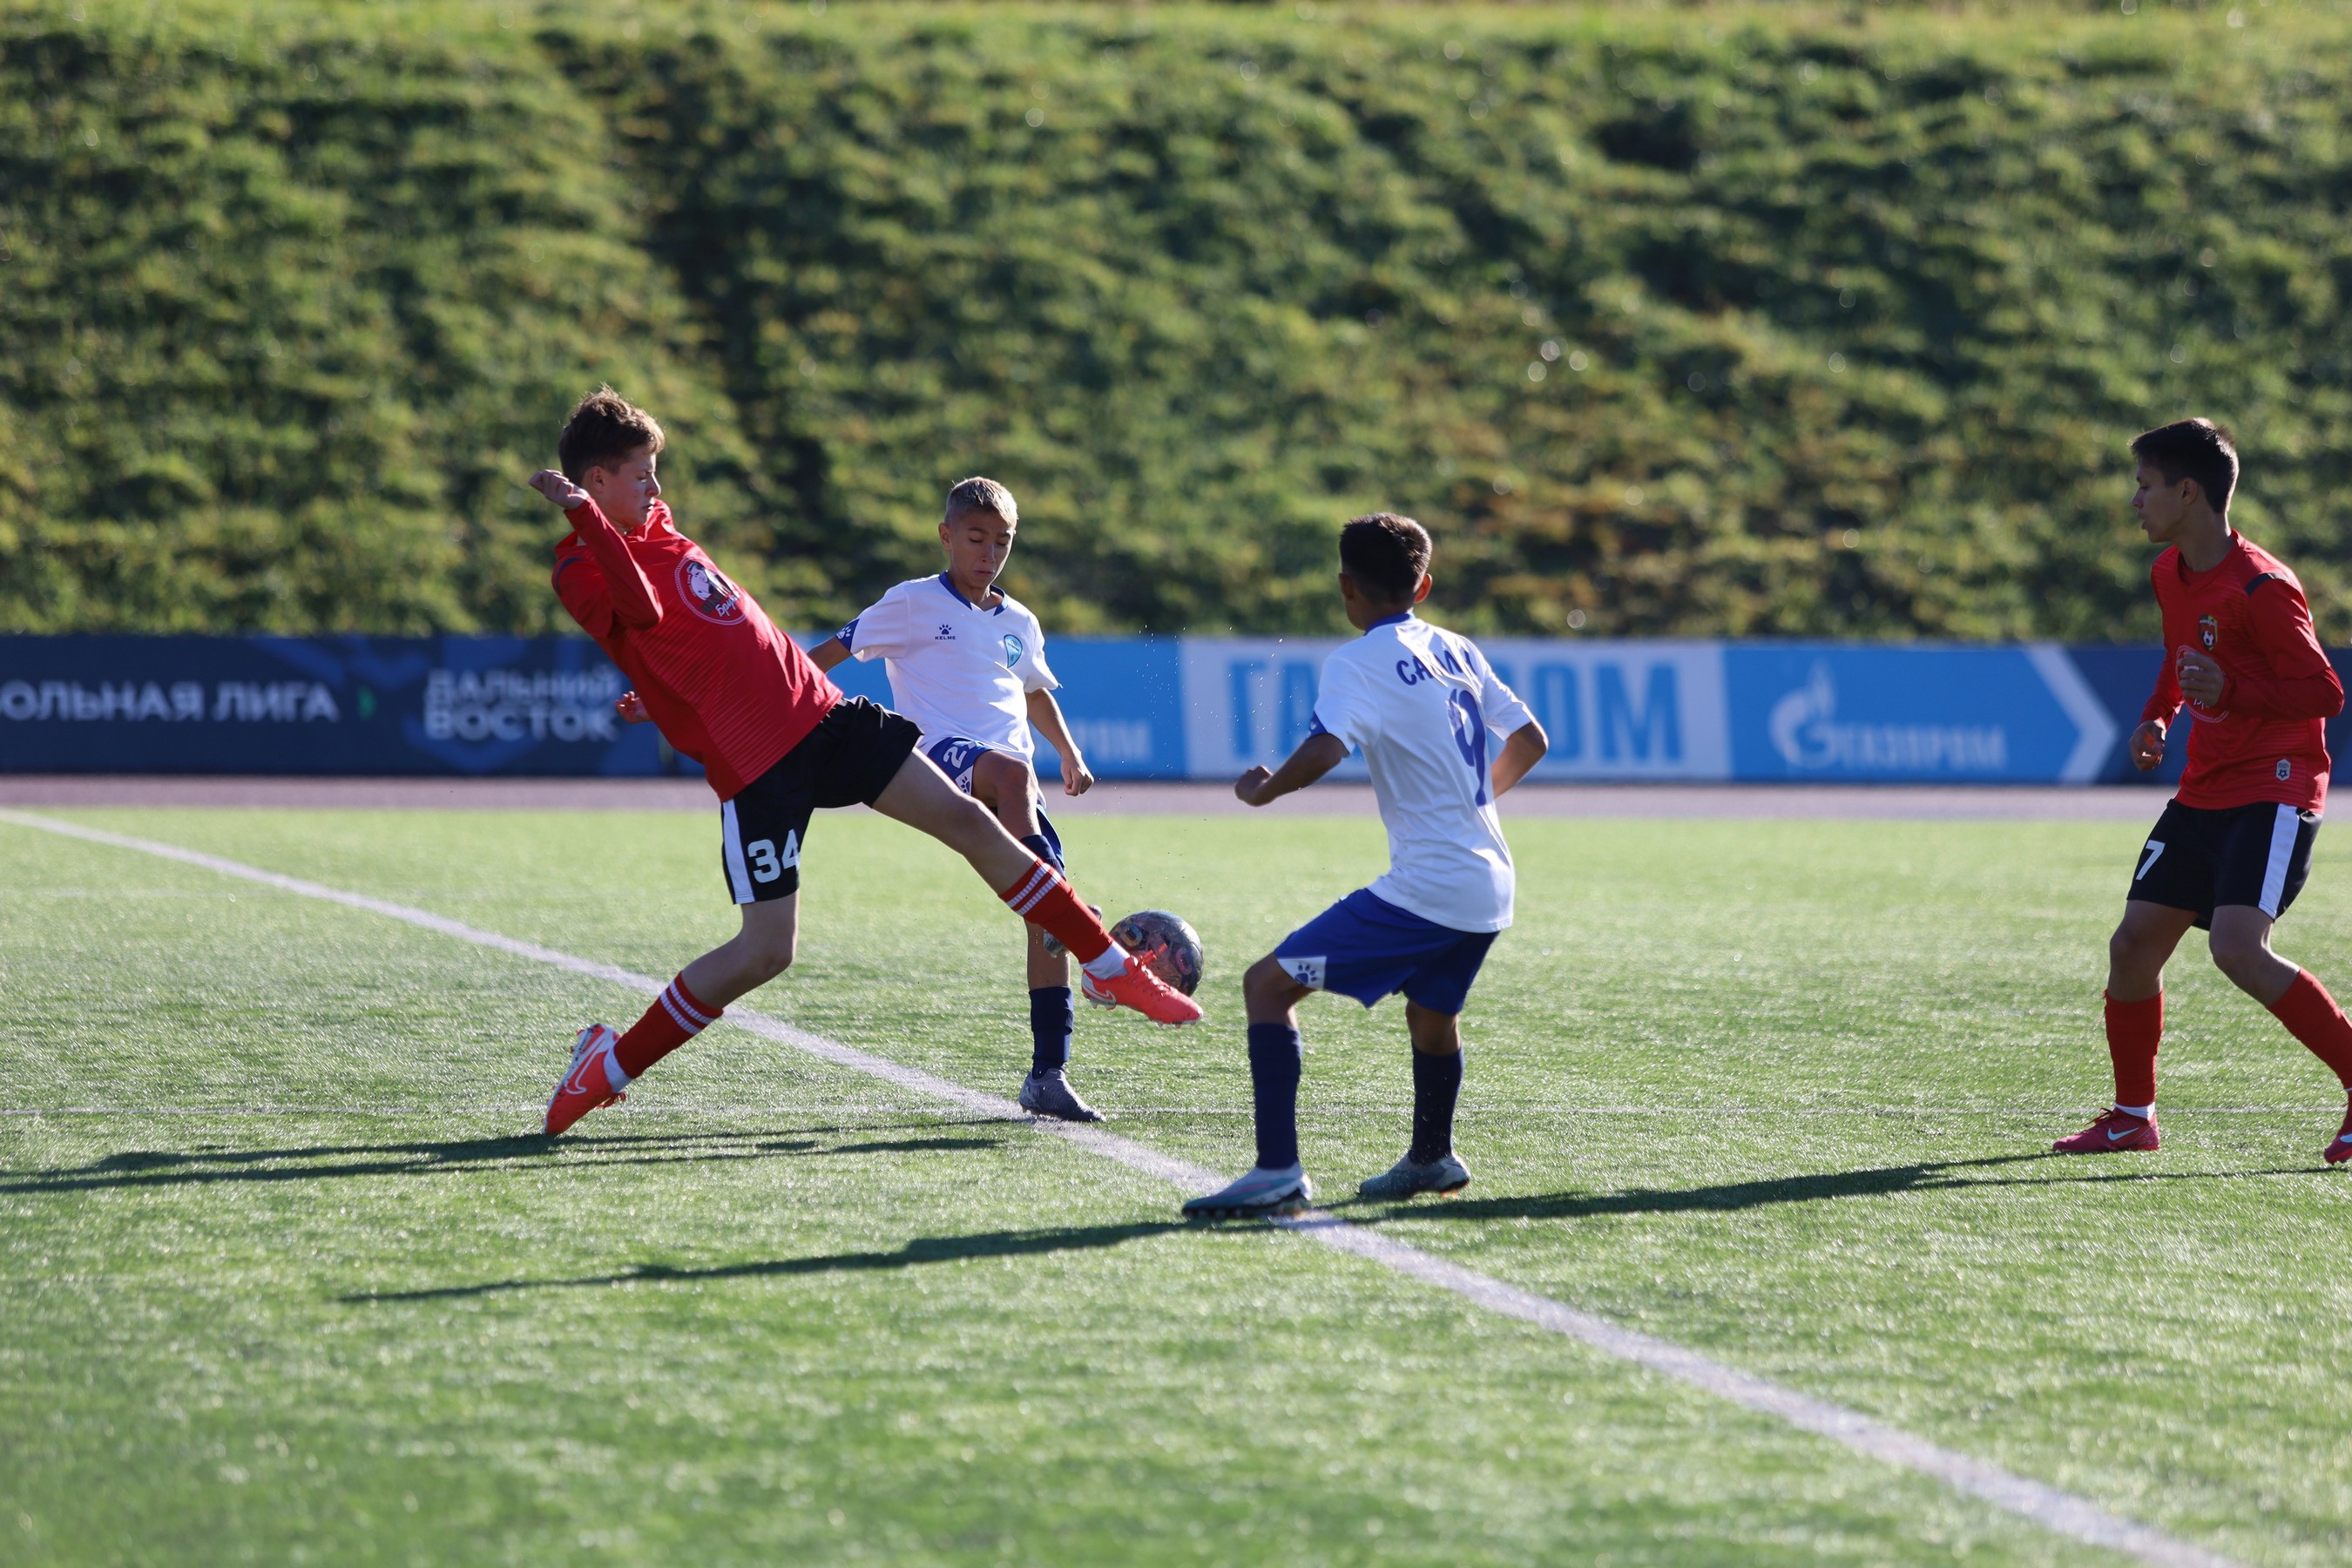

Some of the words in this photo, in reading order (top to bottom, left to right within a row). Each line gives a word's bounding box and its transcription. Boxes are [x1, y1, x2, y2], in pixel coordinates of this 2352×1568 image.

[212, 680, 341, 722] ЛИГА
[425, 702, 618, 740] ВОСТОК
[1448, 688, 1487, 808] 9
[747, 828, 801, 883] 34
[2135, 839, 2166, 881] 7
